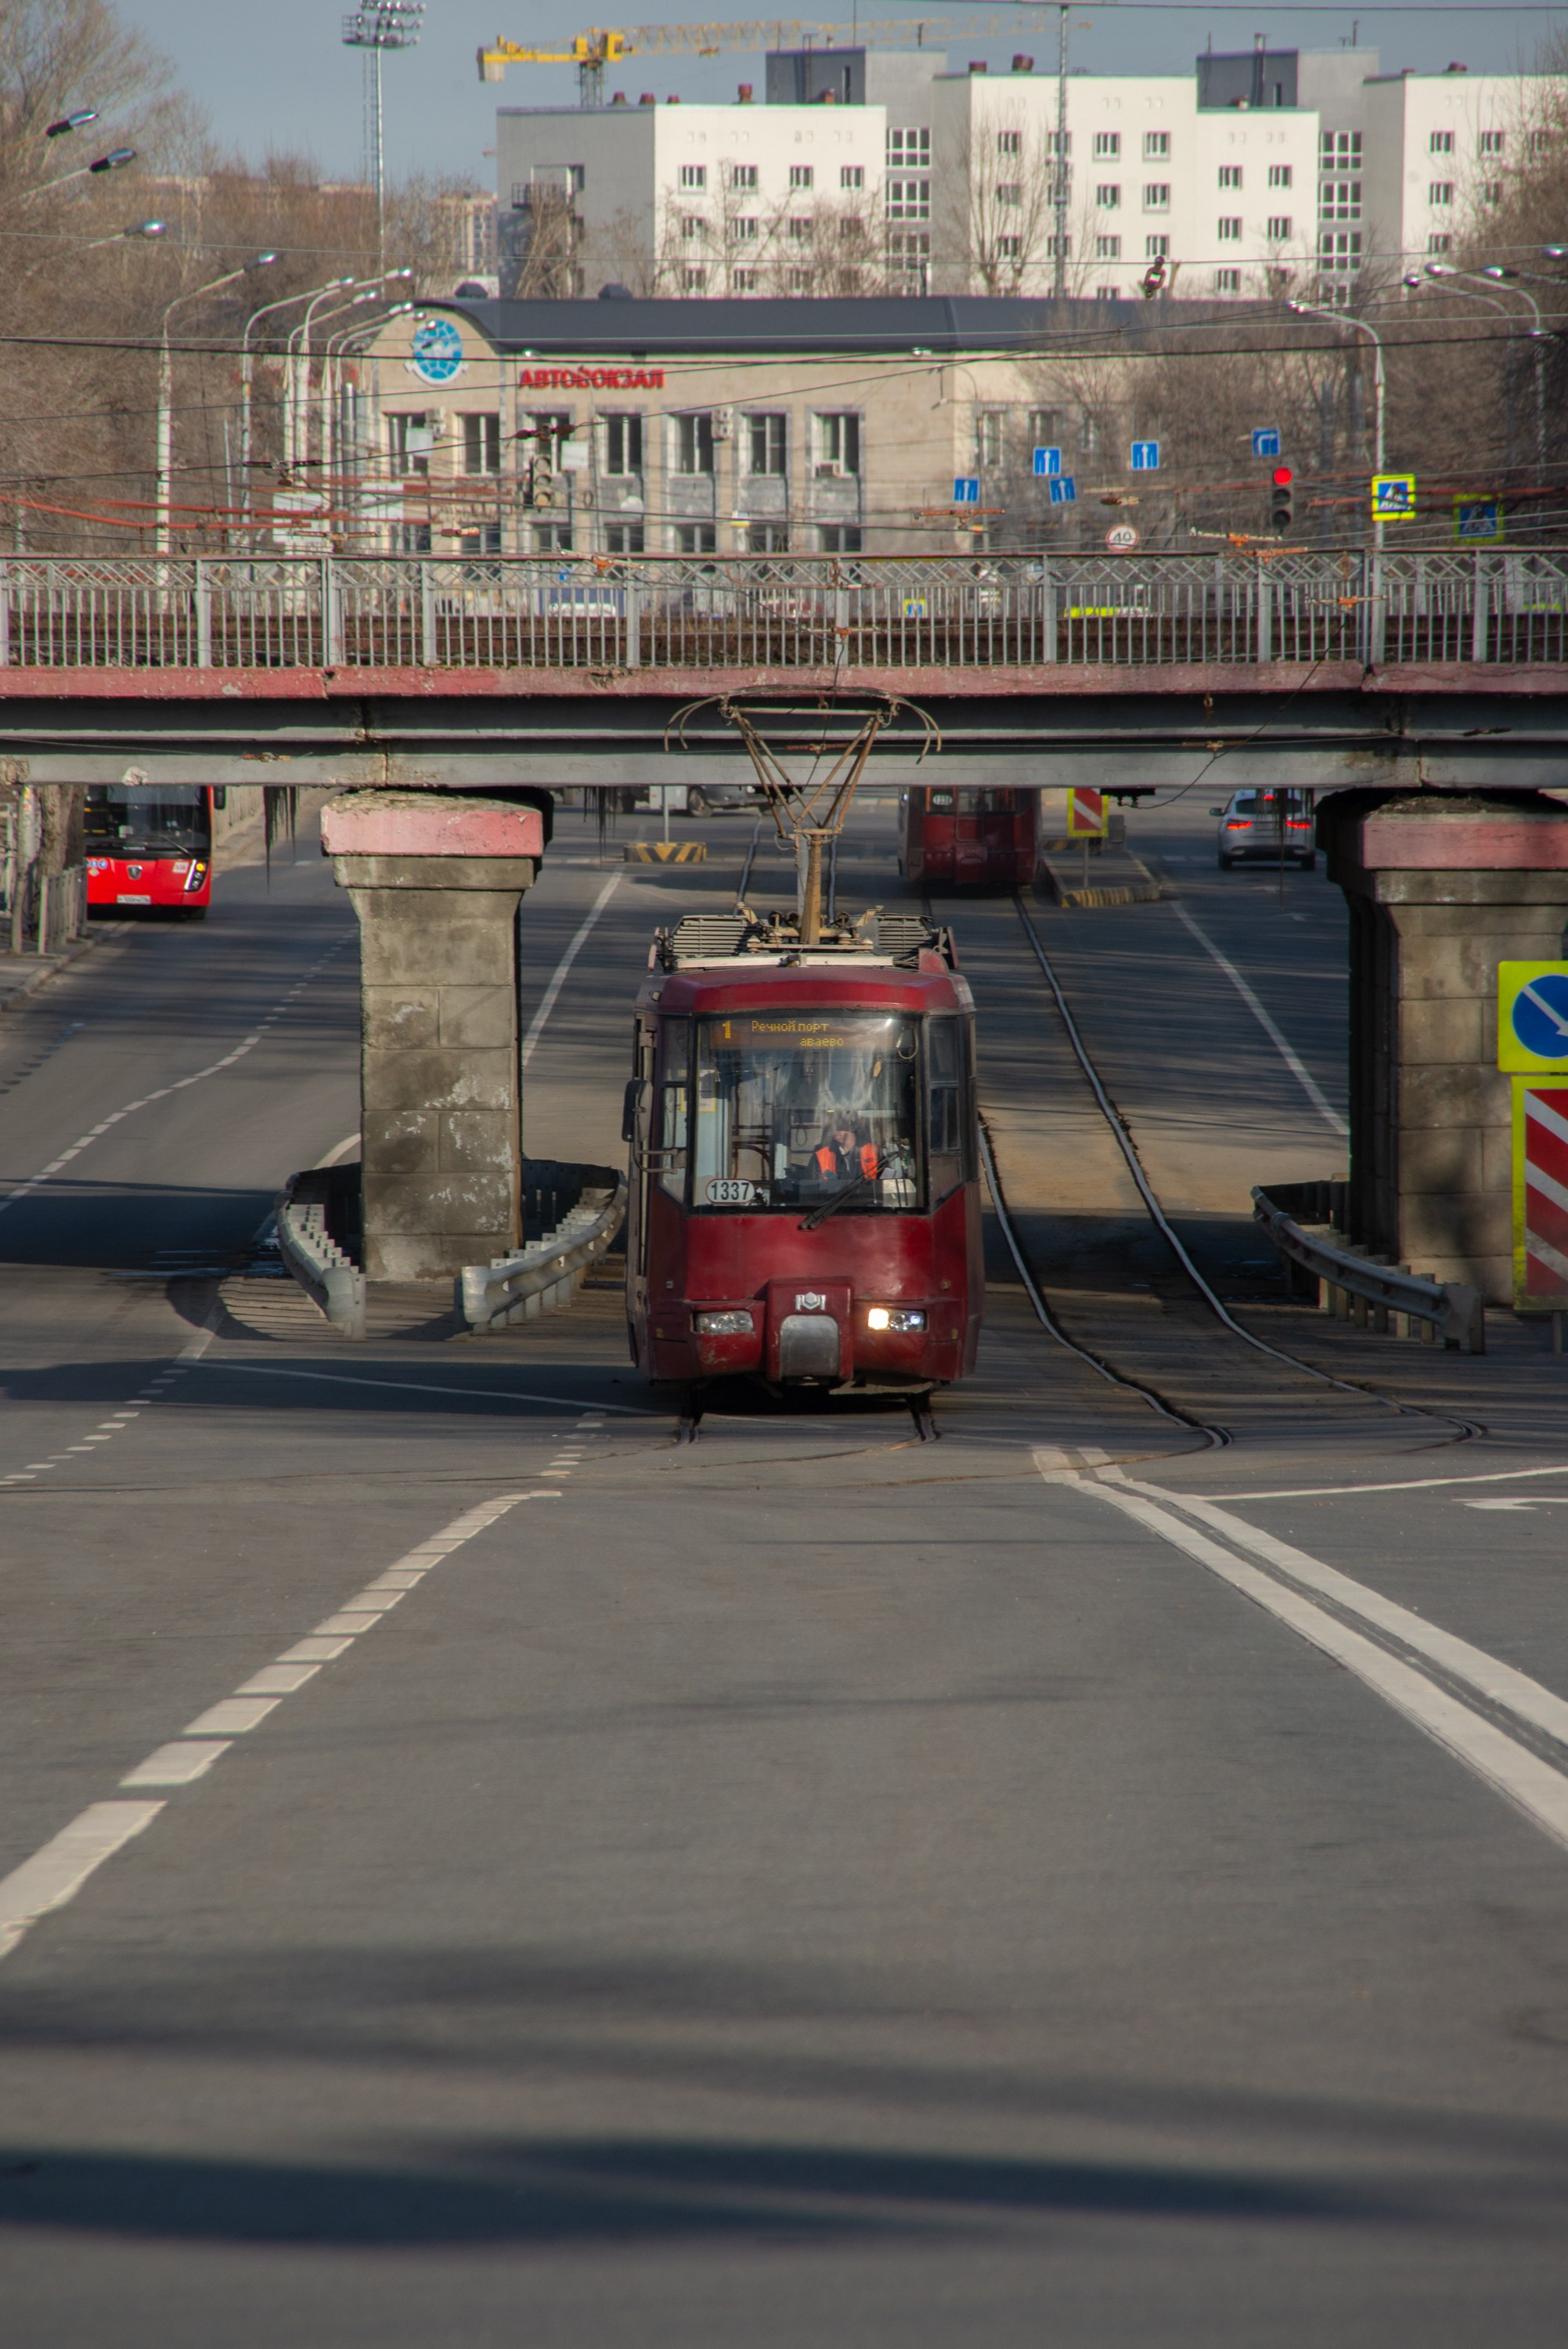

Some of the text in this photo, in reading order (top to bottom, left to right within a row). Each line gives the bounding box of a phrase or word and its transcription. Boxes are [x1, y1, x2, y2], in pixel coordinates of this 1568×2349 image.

[520, 369, 665, 389] АВТОВОКЗАЛ
[1112, 532, 1132, 542] 40
[722, 1020, 731, 1039] 1
[752, 1020, 829, 1033] Речной порт
[800, 1037, 844, 1046] аваево
[711, 1182, 750, 1200] 1337
